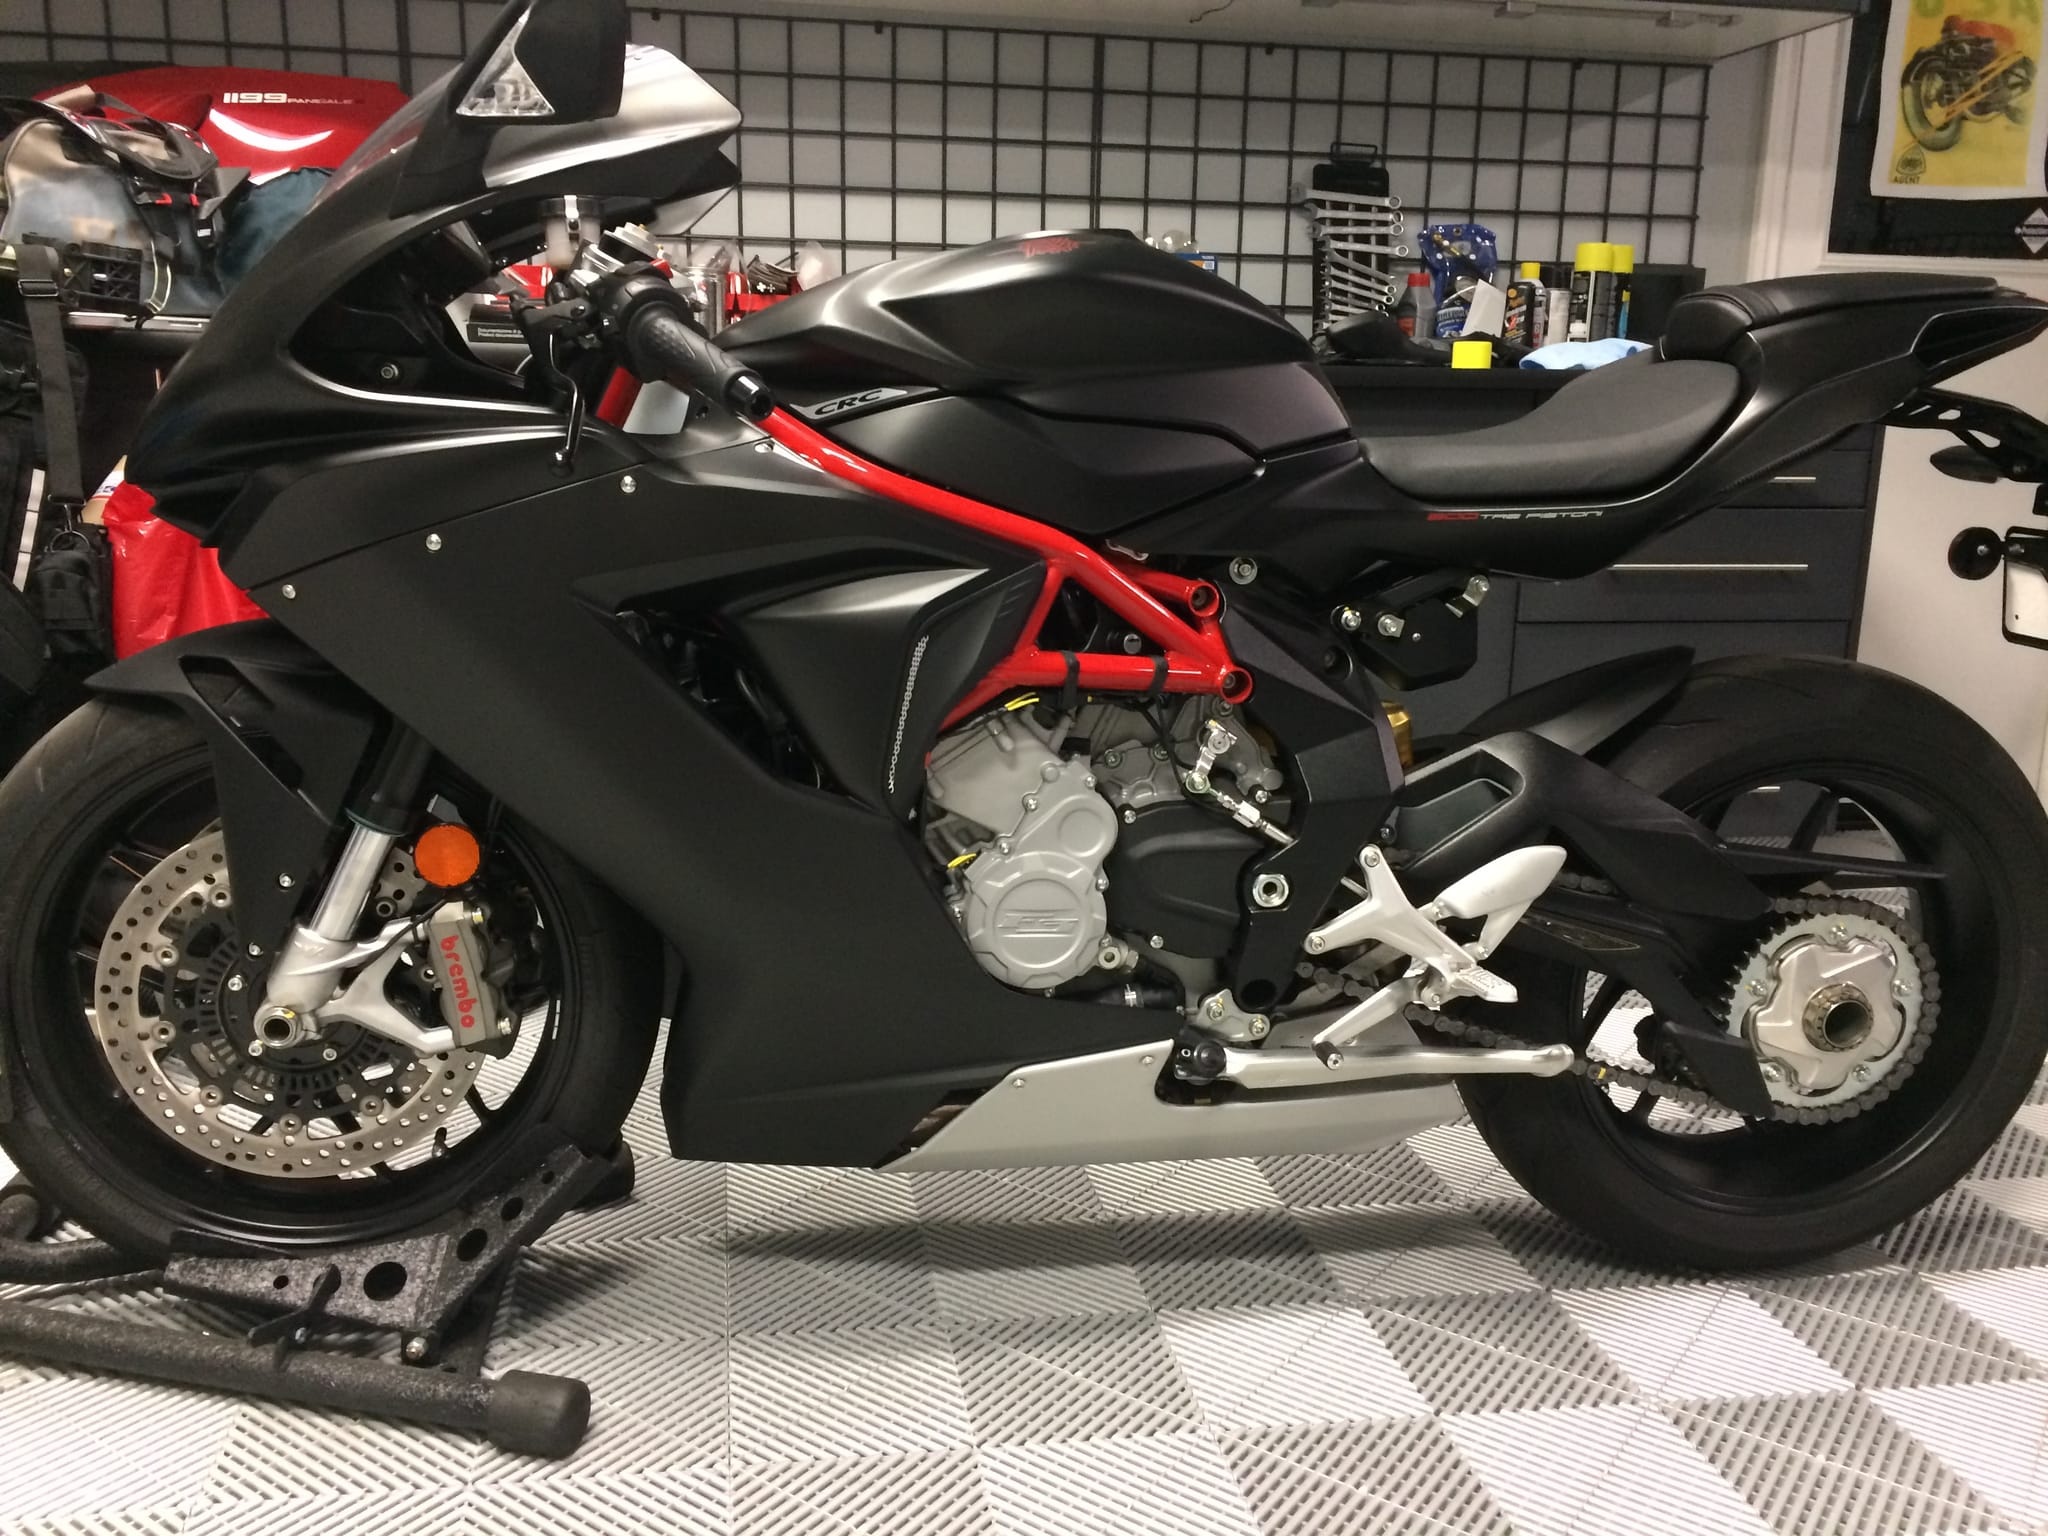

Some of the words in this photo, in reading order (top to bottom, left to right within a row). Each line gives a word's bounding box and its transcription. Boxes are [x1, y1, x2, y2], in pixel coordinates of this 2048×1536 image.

[223, 92, 287, 104] 1199
[814, 389, 882, 415] CRC
[440, 934, 478, 1029] brembo
